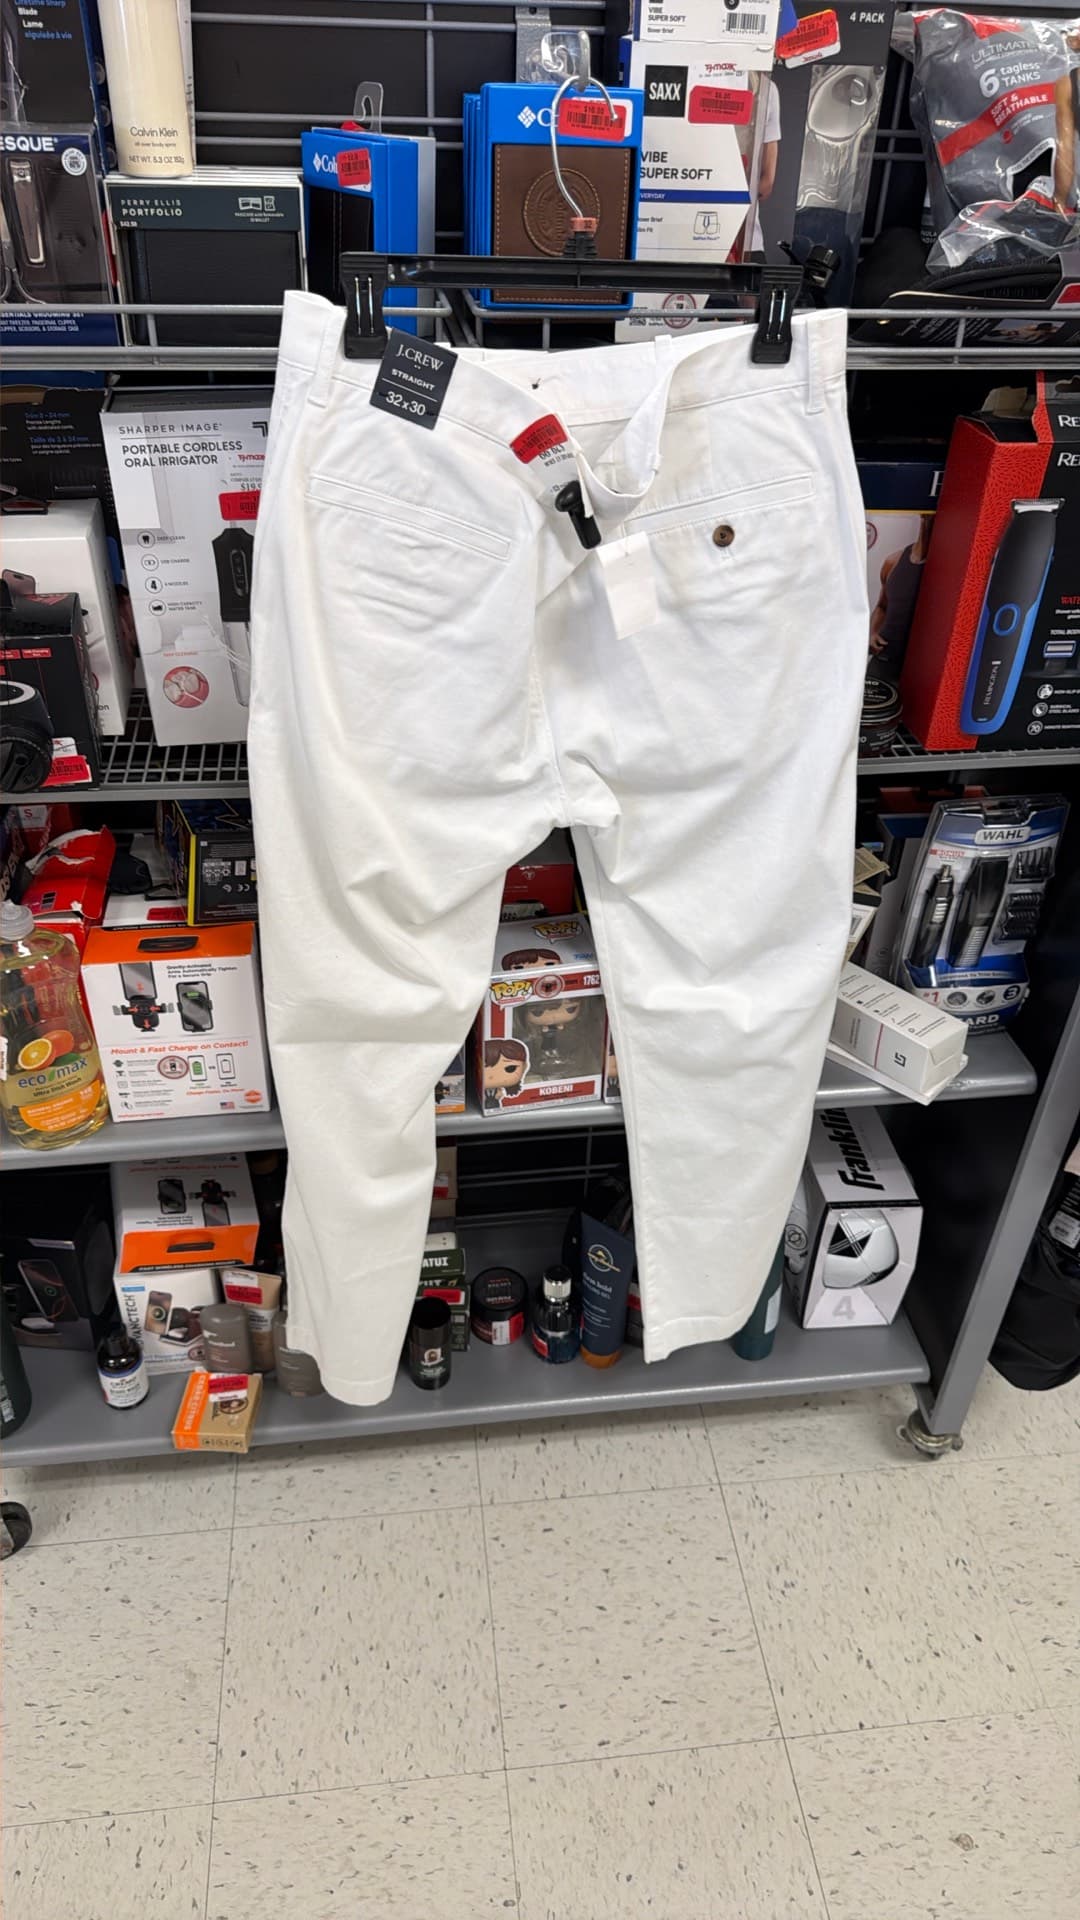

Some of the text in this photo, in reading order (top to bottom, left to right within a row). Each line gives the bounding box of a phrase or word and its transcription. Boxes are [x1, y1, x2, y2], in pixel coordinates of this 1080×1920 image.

[18, 7, 39, 15] Blade
[849, 12, 885, 23] 4 PACK
[23, 20, 43, 28] Lame
[1000, 63, 1040, 76] tagless
[979, 68, 1000, 98] 6
[1001, 72, 1041, 87] TANKS
[649, 82, 682, 101] SAXX
[130, 126, 178, 137] Calvin Klein
[641, 151, 668, 163] VIBE
[640, 167, 713, 180] SUPER SOFT
[122, 208, 182, 216] PORTFOLIO
[396, 344, 444, 371] J.CREW
[391, 368, 436, 391] STRAIGHT
[386, 391, 426, 416] 32x30
[119, 423, 219, 434] SHARPER IMAGE
[122, 441, 243, 455] PORTABLE CORDLESS
[124, 454, 218, 468] ORAL IRRIGATOR
[983, 829, 1024, 840] WAHL
[583, 975, 600, 986] 1762
[1005, 987, 1018, 998] 3
[168, 1043, 199, 1053] Charge
[214, 1041, 249, 1050] Contact!
[18, 1058, 88, 1088] eco max
[540, 1085, 574, 1096] KOBENI
[832, 1295, 856, 1320] 4
